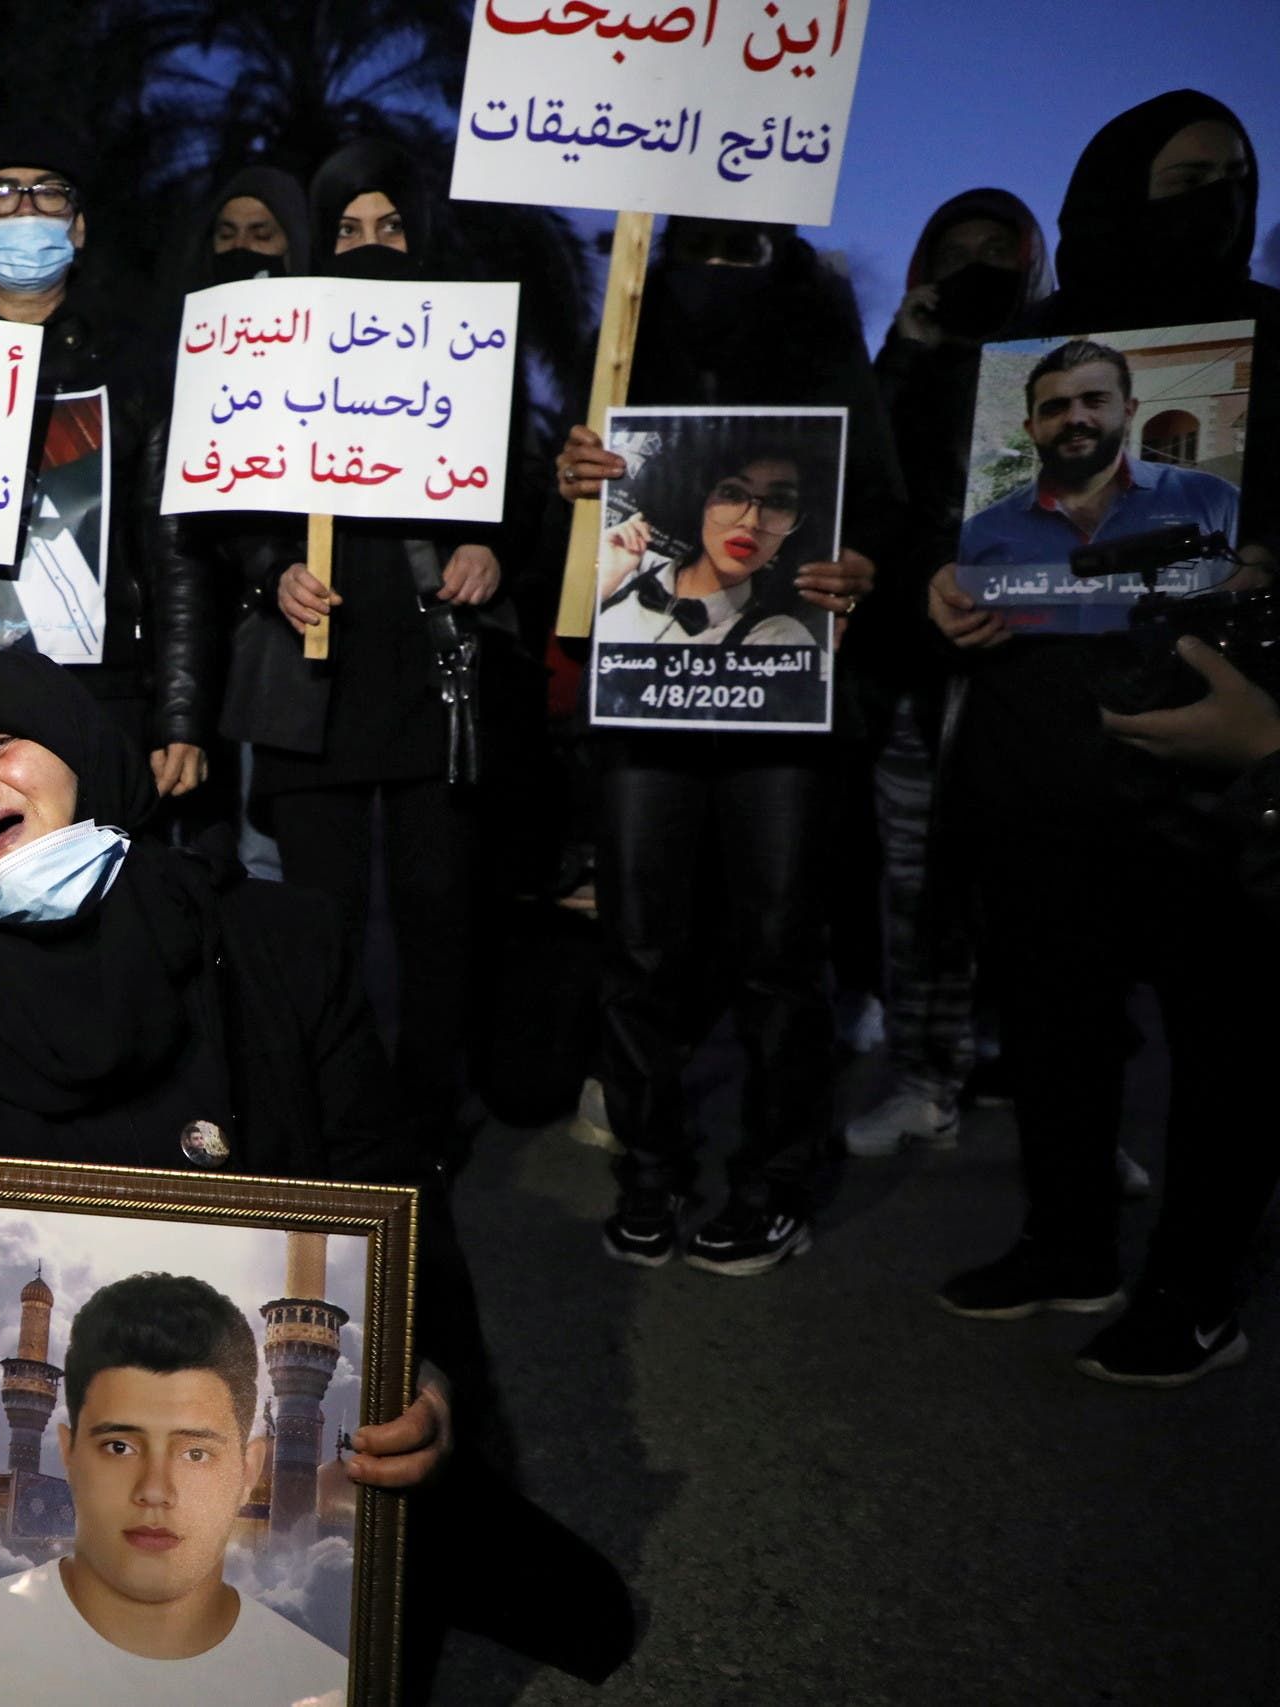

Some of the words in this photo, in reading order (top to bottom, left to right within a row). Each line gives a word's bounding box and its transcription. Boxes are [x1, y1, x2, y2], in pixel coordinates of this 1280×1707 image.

[470, 96, 702, 163] التحقيقات
[716, 115, 831, 183] نتائج
[185, 307, 311, 357] النيترات
[329, 301, 433, 354] أدخل
[448, 321, 507, 361] من
[211, 384, 263, 424] من
[284, 376, 452, 429] ولحساب
[182, 440, 287, 493] نعرف
[310, 441, 403, 486] حقنا
[425, 455, 489, 501] من
[983, 572, 1049, 601] قعدان
[598, 654, 658, 674] مستو
[664, 649, 717, 677] روان
[725, 651, 812, 678] الشهيدة
[640, 684, 766, 709] 4/8/2020
